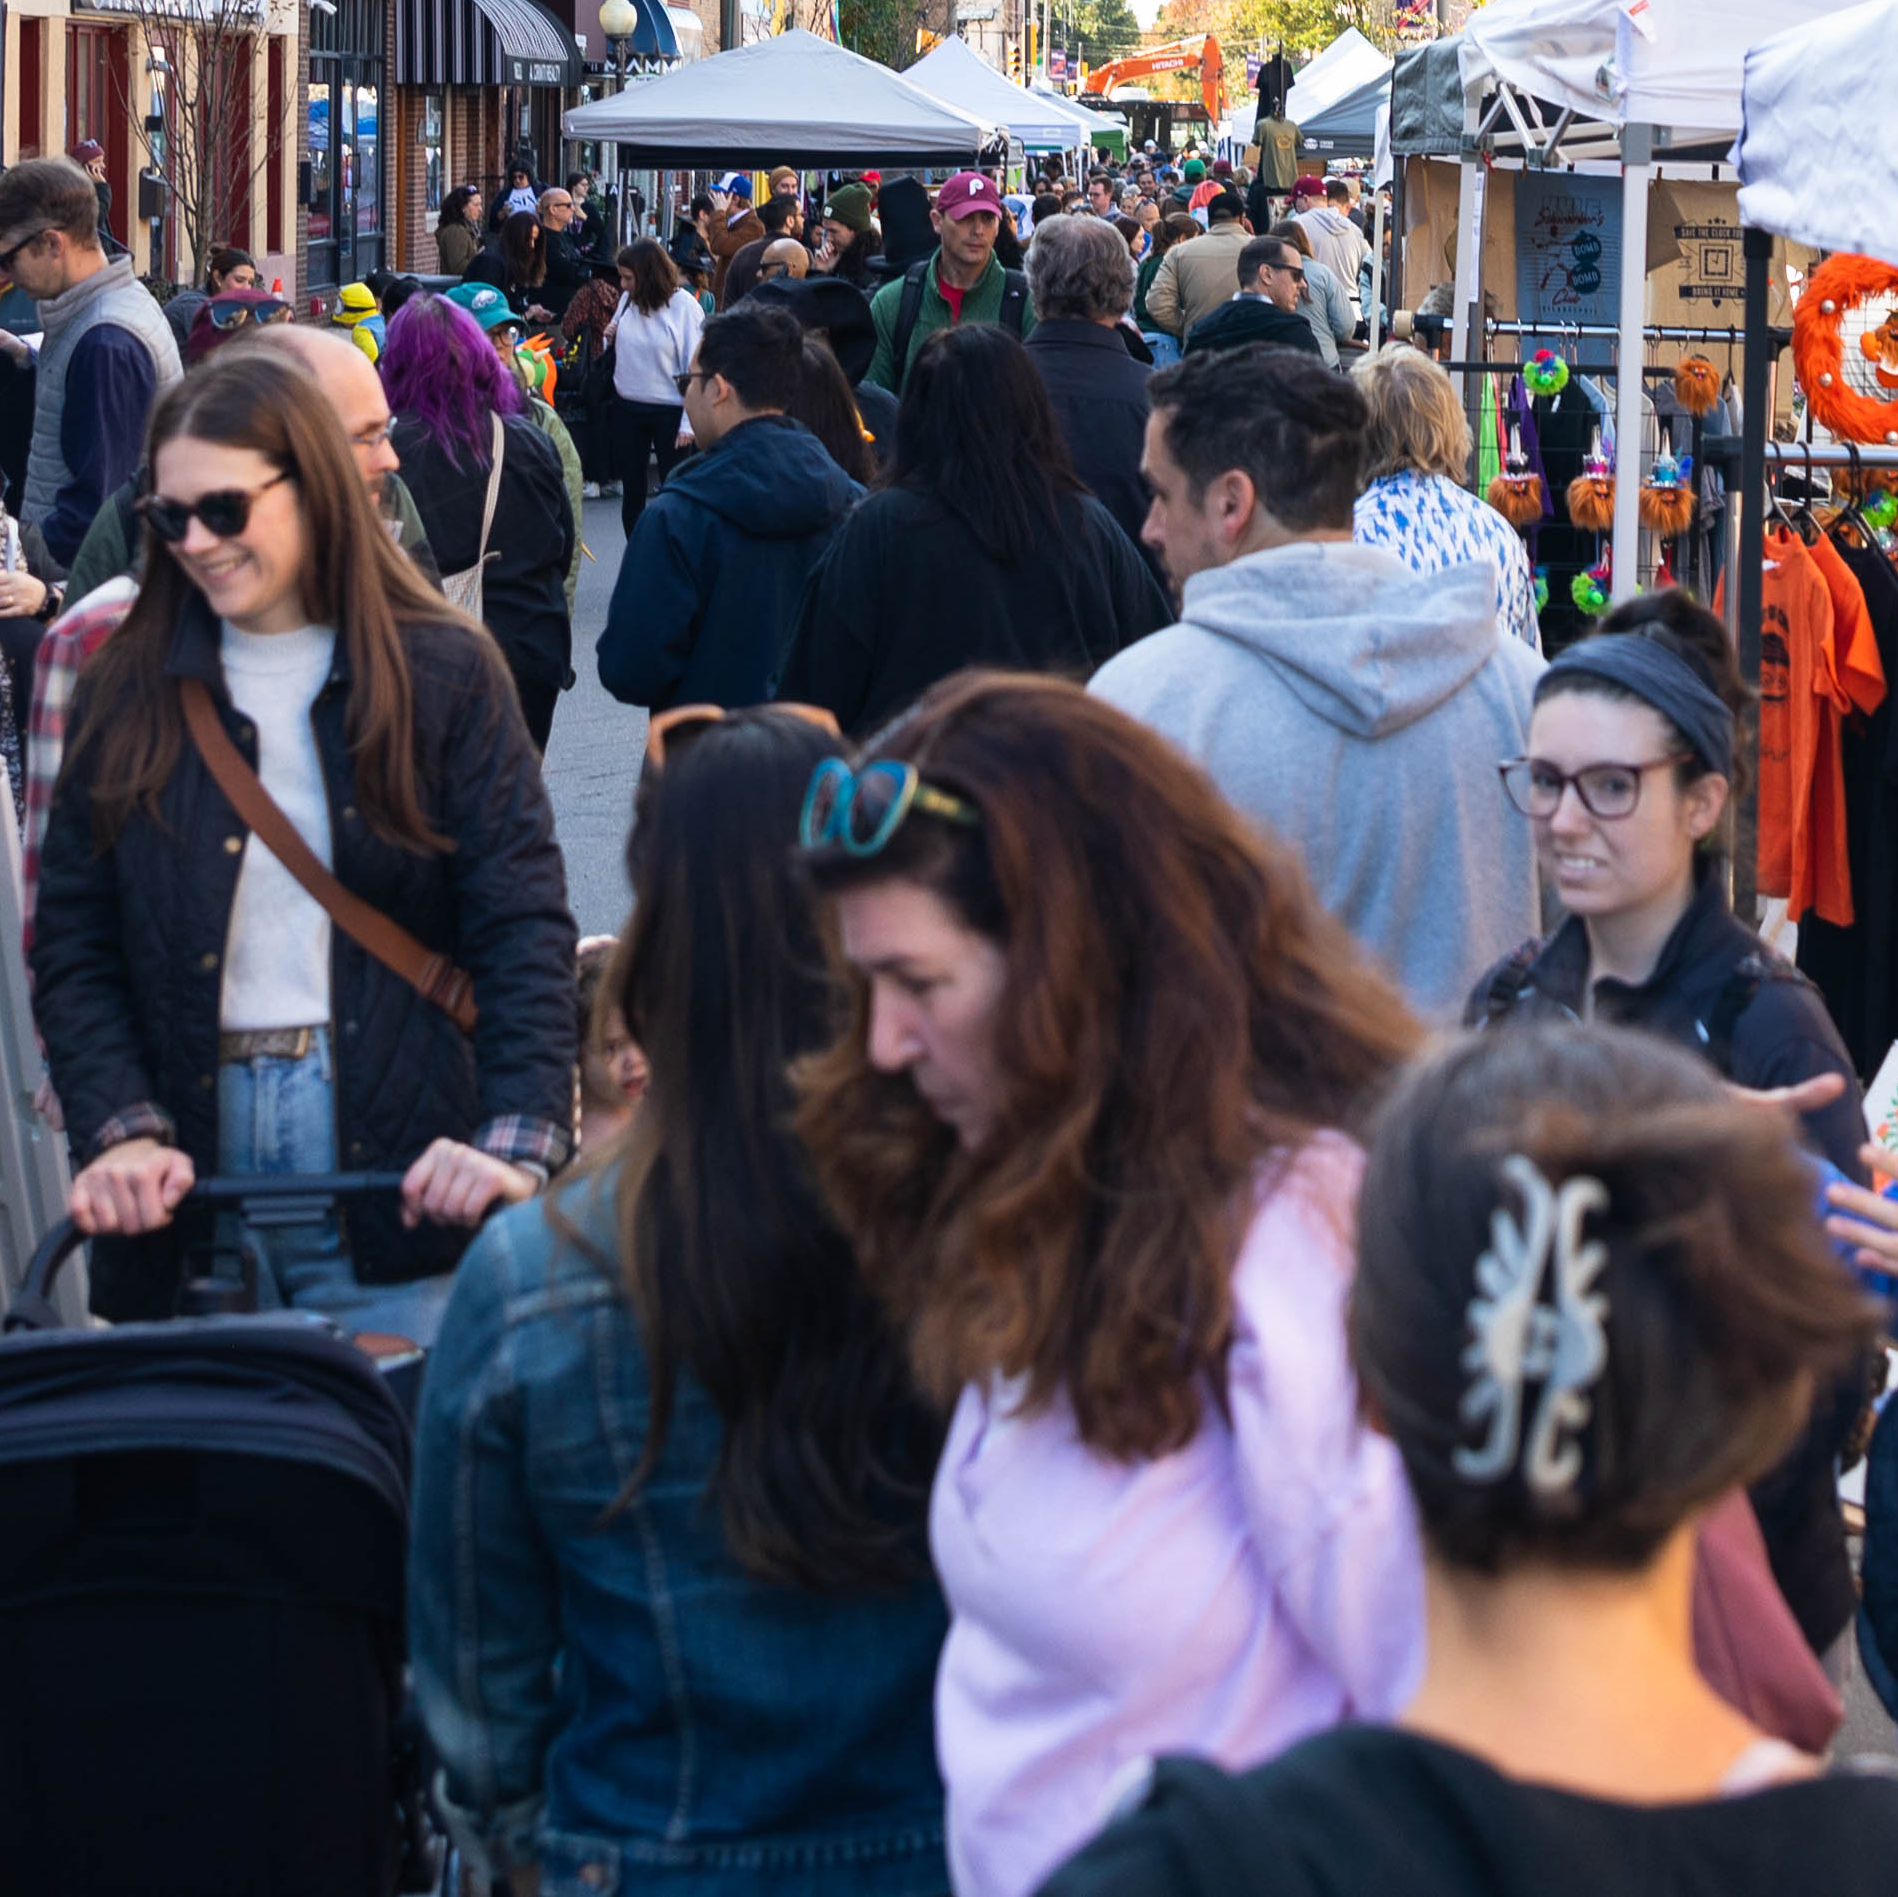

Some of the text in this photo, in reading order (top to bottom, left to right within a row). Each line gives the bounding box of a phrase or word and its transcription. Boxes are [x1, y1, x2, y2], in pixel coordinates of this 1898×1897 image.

[1151, 58, 1184, 70] HITACHI
[1574, 241, 1600, 255] BOMB
[1572, 270, 1599, 286] BOMB
